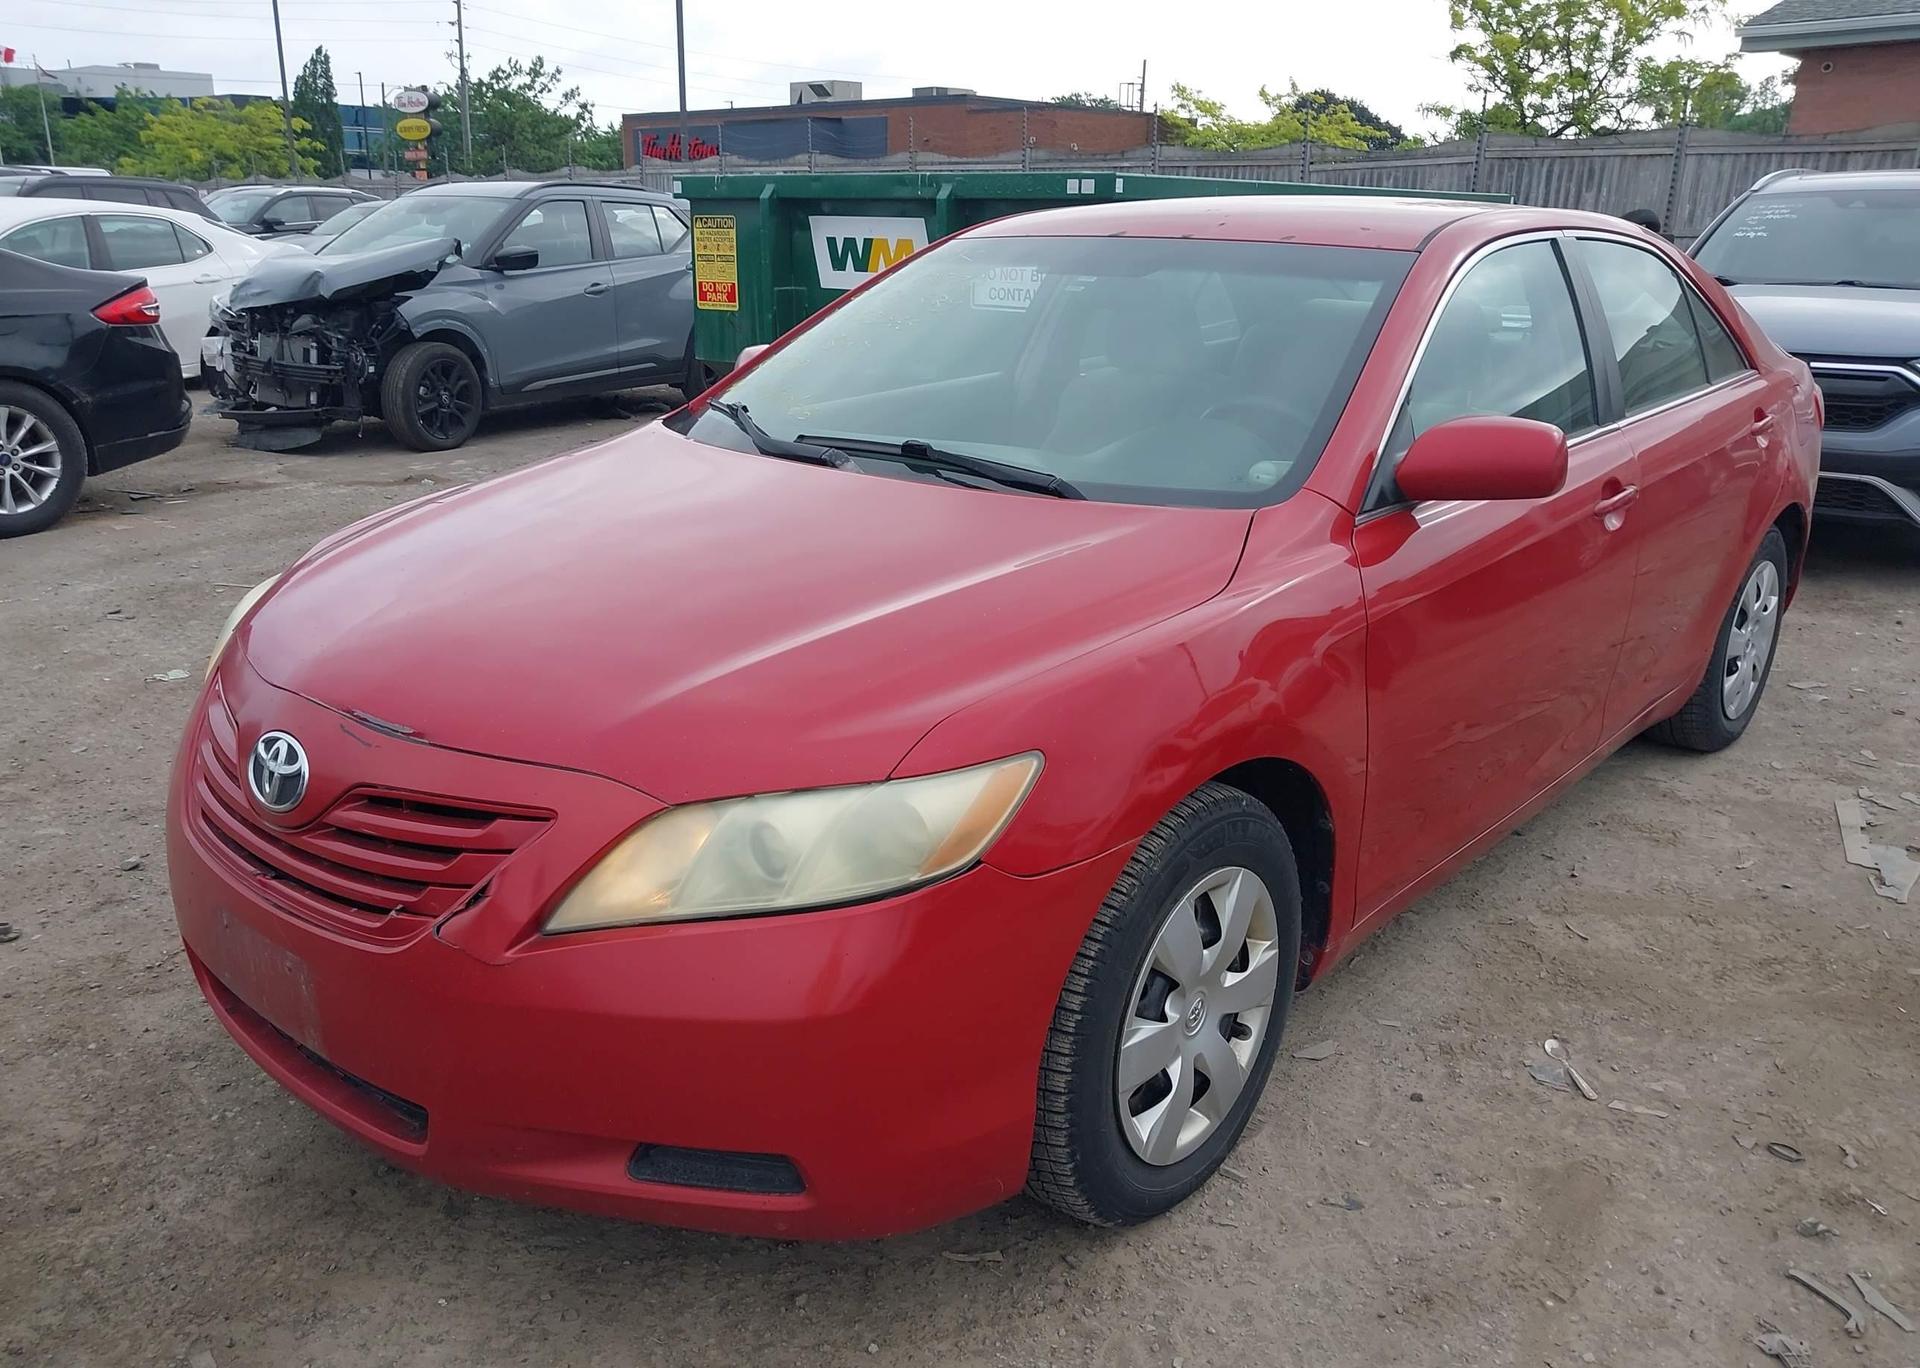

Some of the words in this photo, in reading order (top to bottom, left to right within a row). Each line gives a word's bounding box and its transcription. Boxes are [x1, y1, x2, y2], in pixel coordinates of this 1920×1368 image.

[702, 217, 734, 228] CAUTION
[826, 236, 915, 273] WM
[1000, 268, 1025, 281] NOT
[702, 282, 714, 292] DO
[716, 283, 733, 293] NOT
[706, 292, 729, 302] PARK
